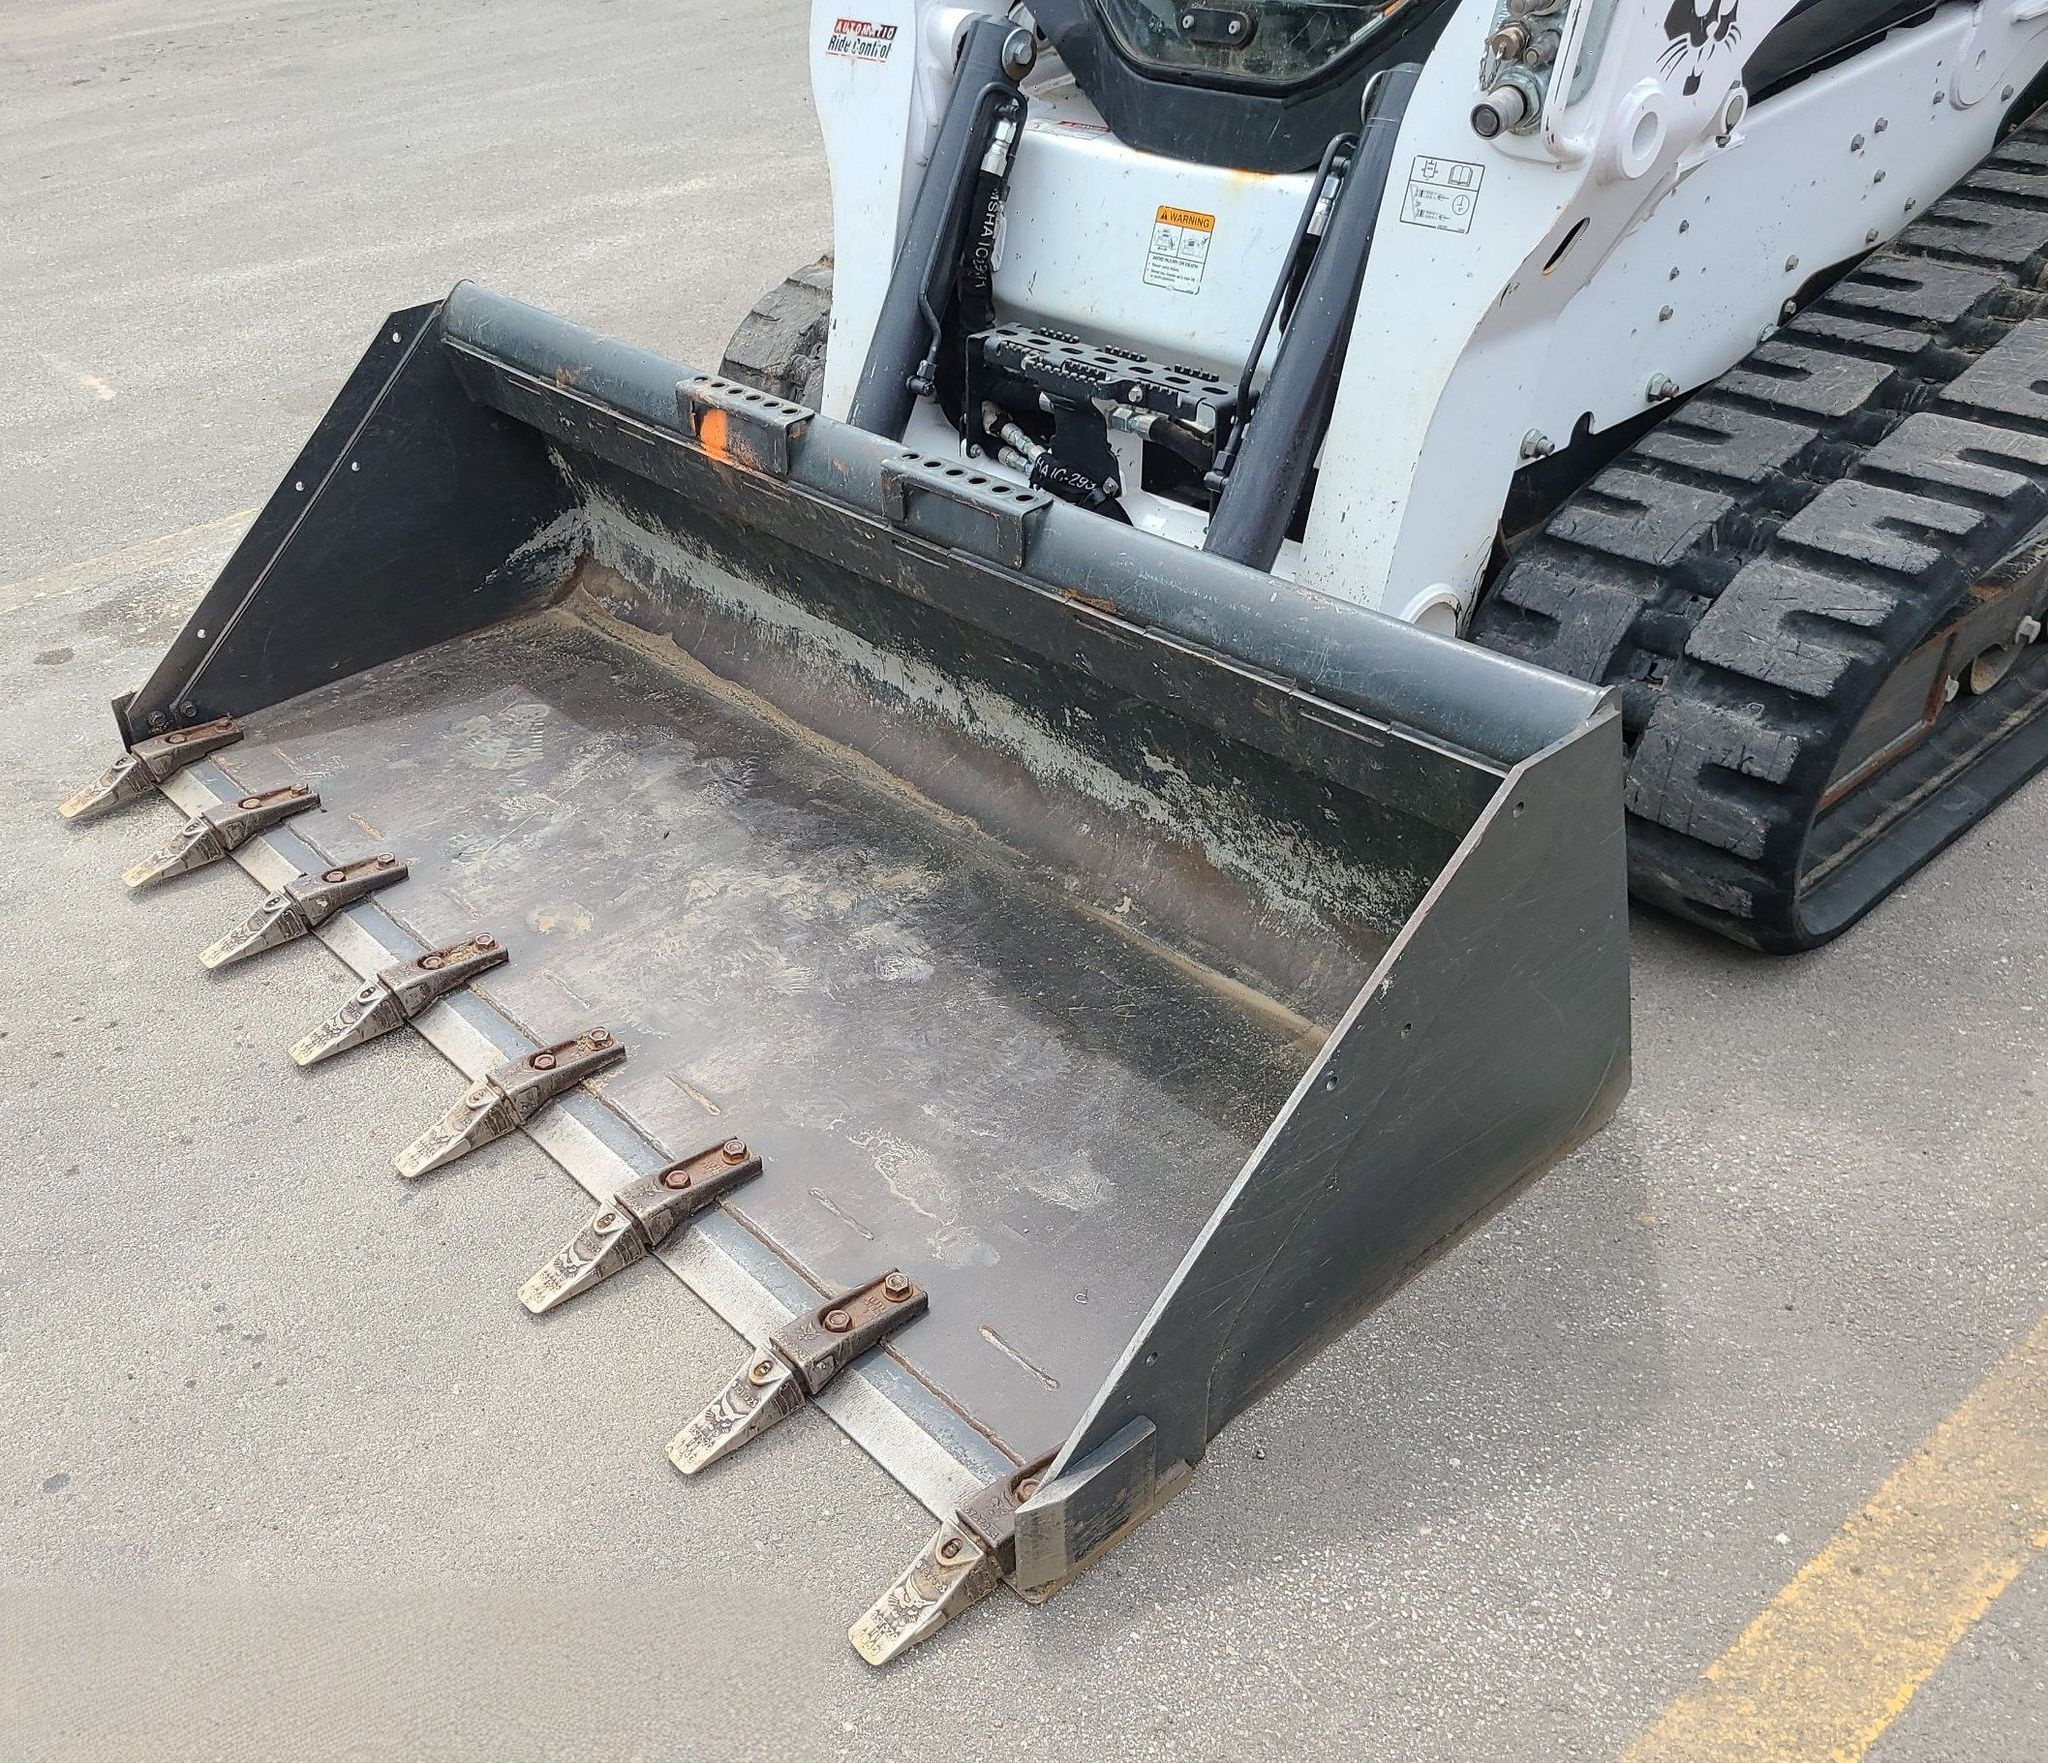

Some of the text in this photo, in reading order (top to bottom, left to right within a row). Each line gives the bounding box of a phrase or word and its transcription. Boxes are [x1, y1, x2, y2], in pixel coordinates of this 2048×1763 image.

[828, 35, 892, 58] Ride Control
[1170, 214, 1210, 228] WARNING
